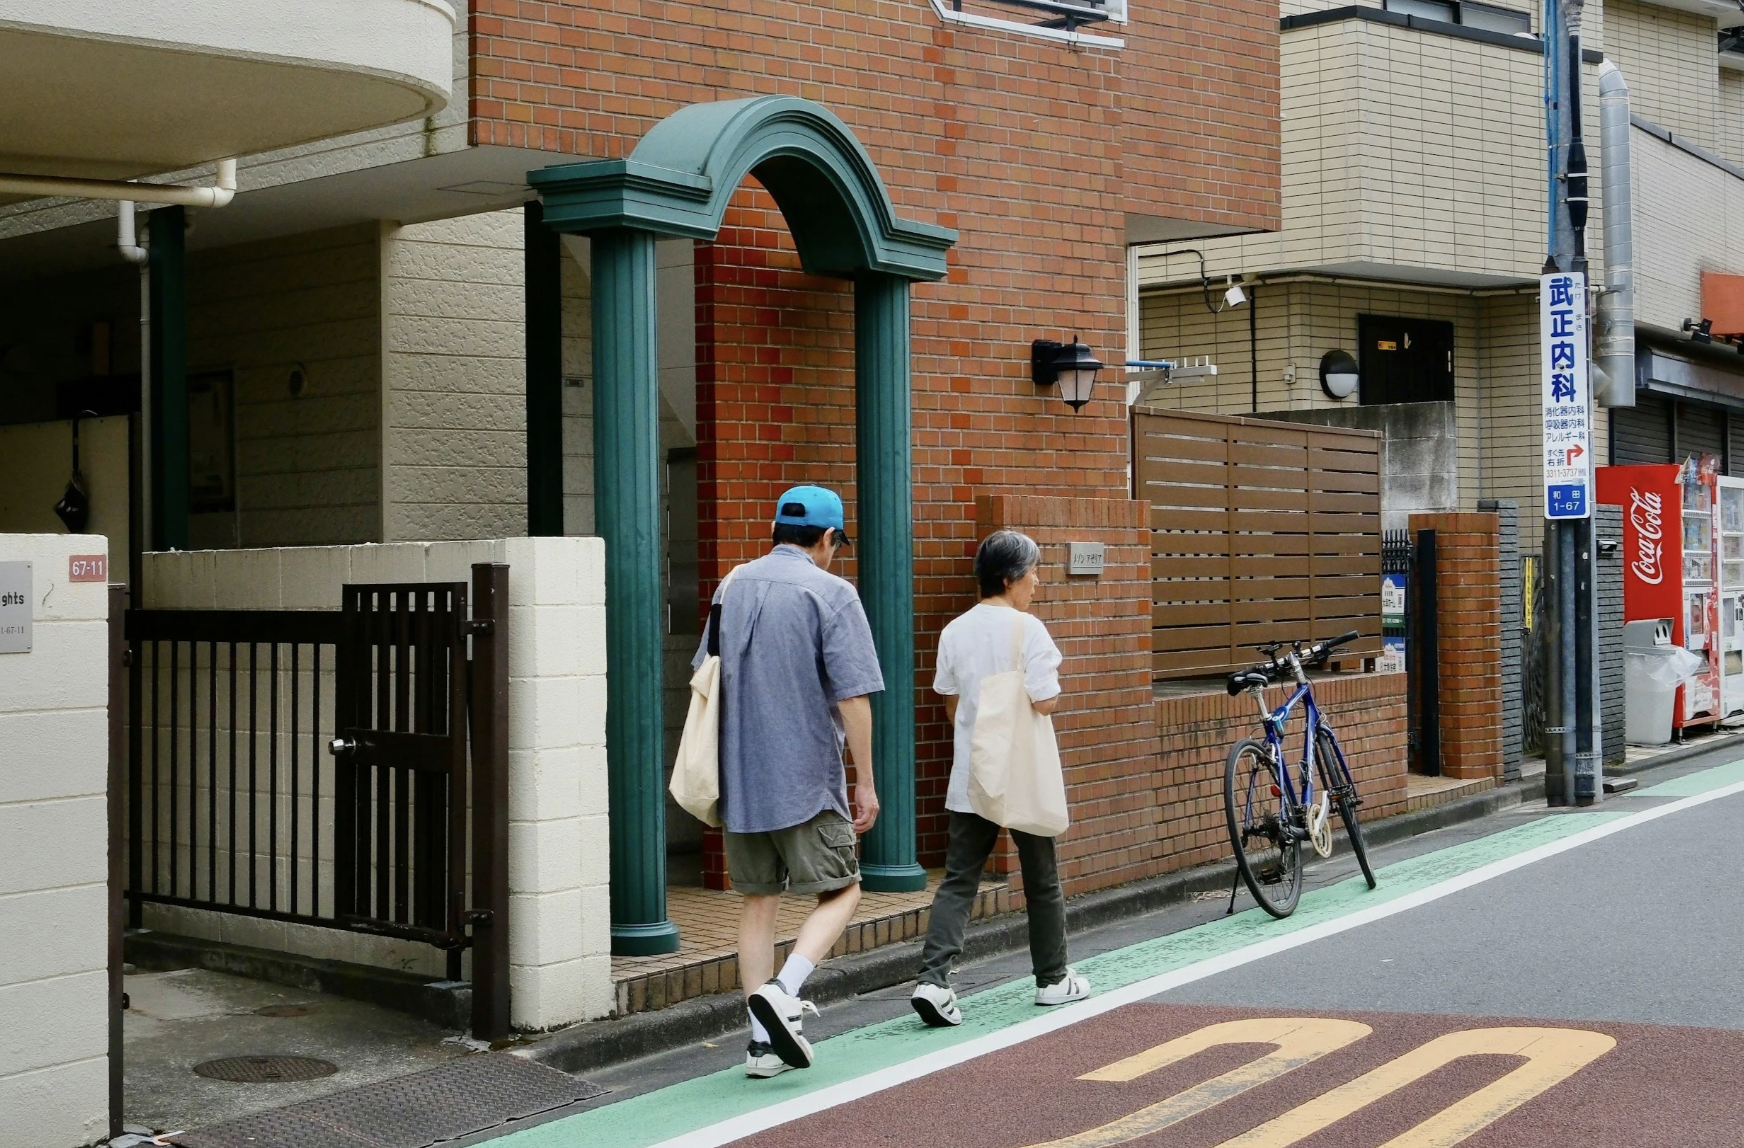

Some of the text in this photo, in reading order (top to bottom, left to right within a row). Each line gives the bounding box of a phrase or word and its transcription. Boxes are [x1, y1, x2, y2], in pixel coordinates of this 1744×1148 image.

[1549, 276, 1576, 403] 武正内科
[1545, 405, 1585, 418] 消化器内科
[1545, 418, 1585, 430] 呼吸器内科
[1546, 431, 1586, 443] アレルギー科
[1546, 468, 1577, 478] 3311-3737
[1553, 501, 1580, 511] 1-67
[1630, 486, 1663, 585] Coca-Cola
[72, 560, 103, 576] 67-11
